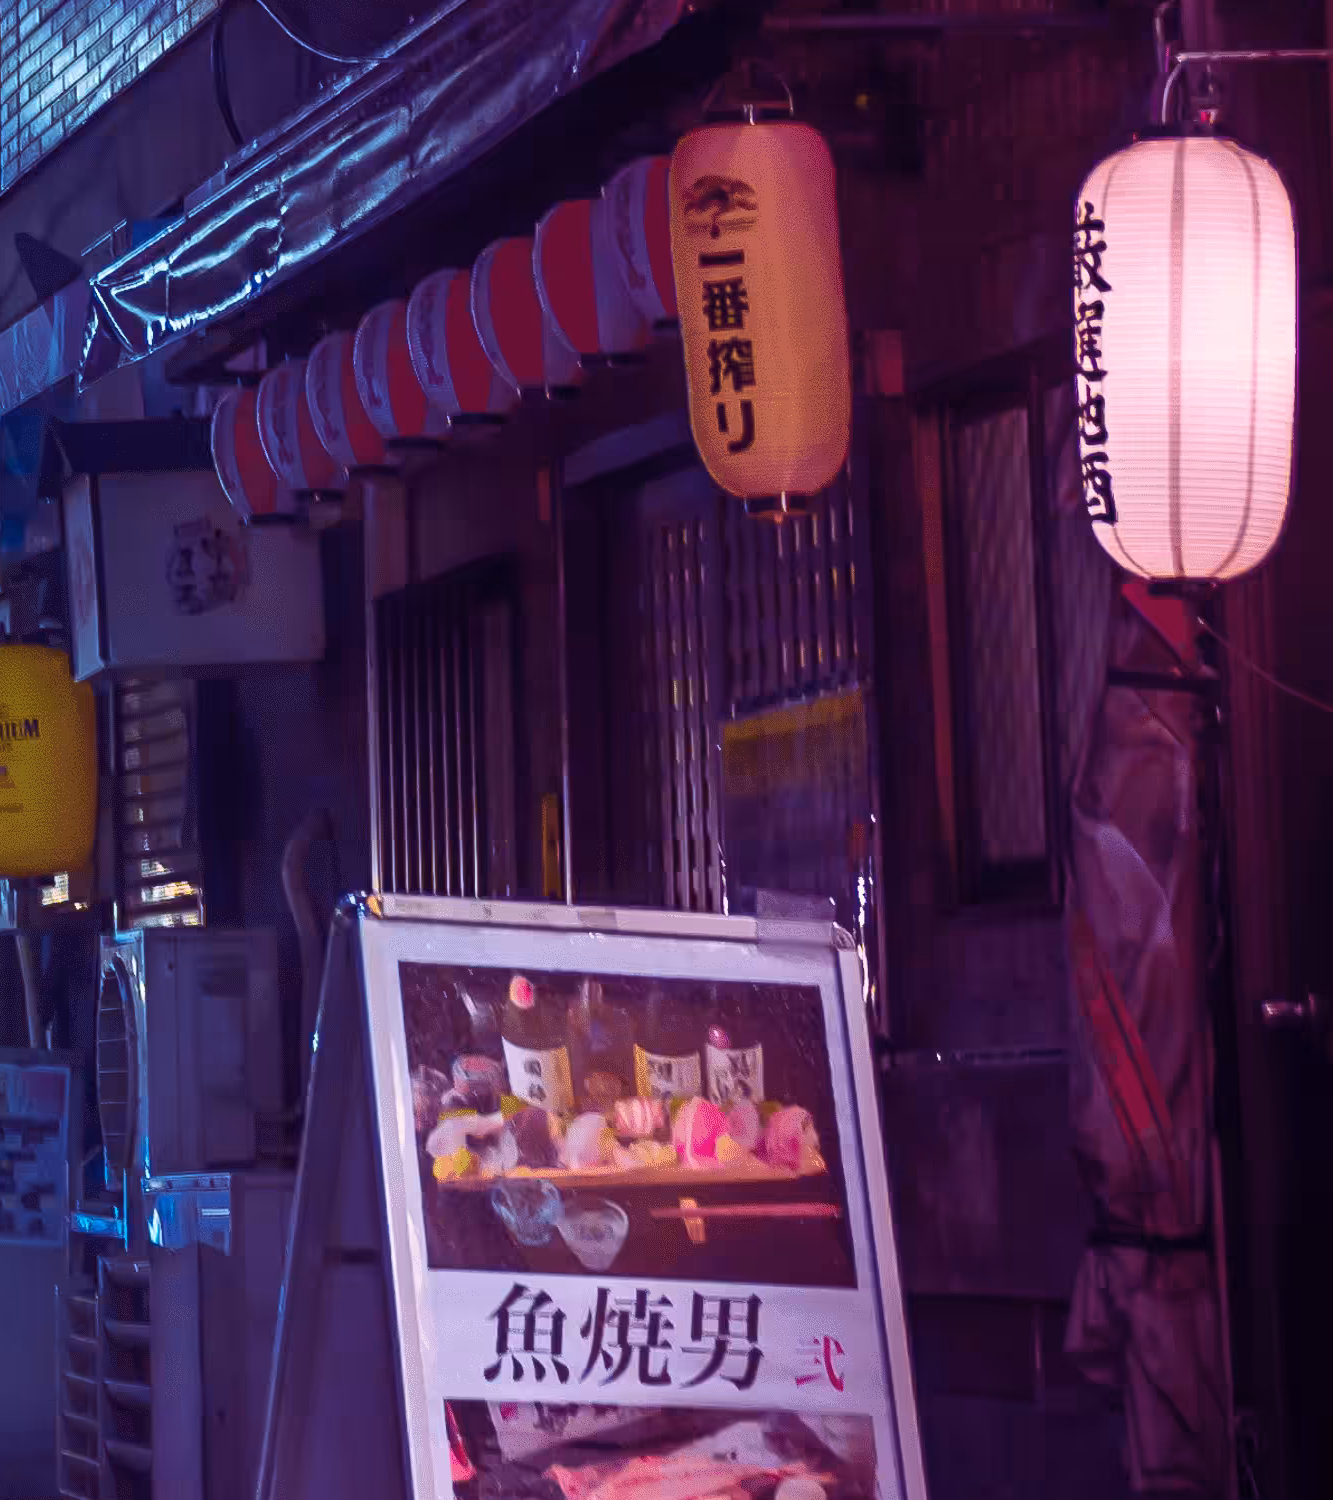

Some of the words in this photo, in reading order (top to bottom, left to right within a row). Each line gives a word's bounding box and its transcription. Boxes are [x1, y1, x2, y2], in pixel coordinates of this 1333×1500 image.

[697, 248, 758, 455] 一番搾り
[482, 1279, 769, 1393] 魚焼男
